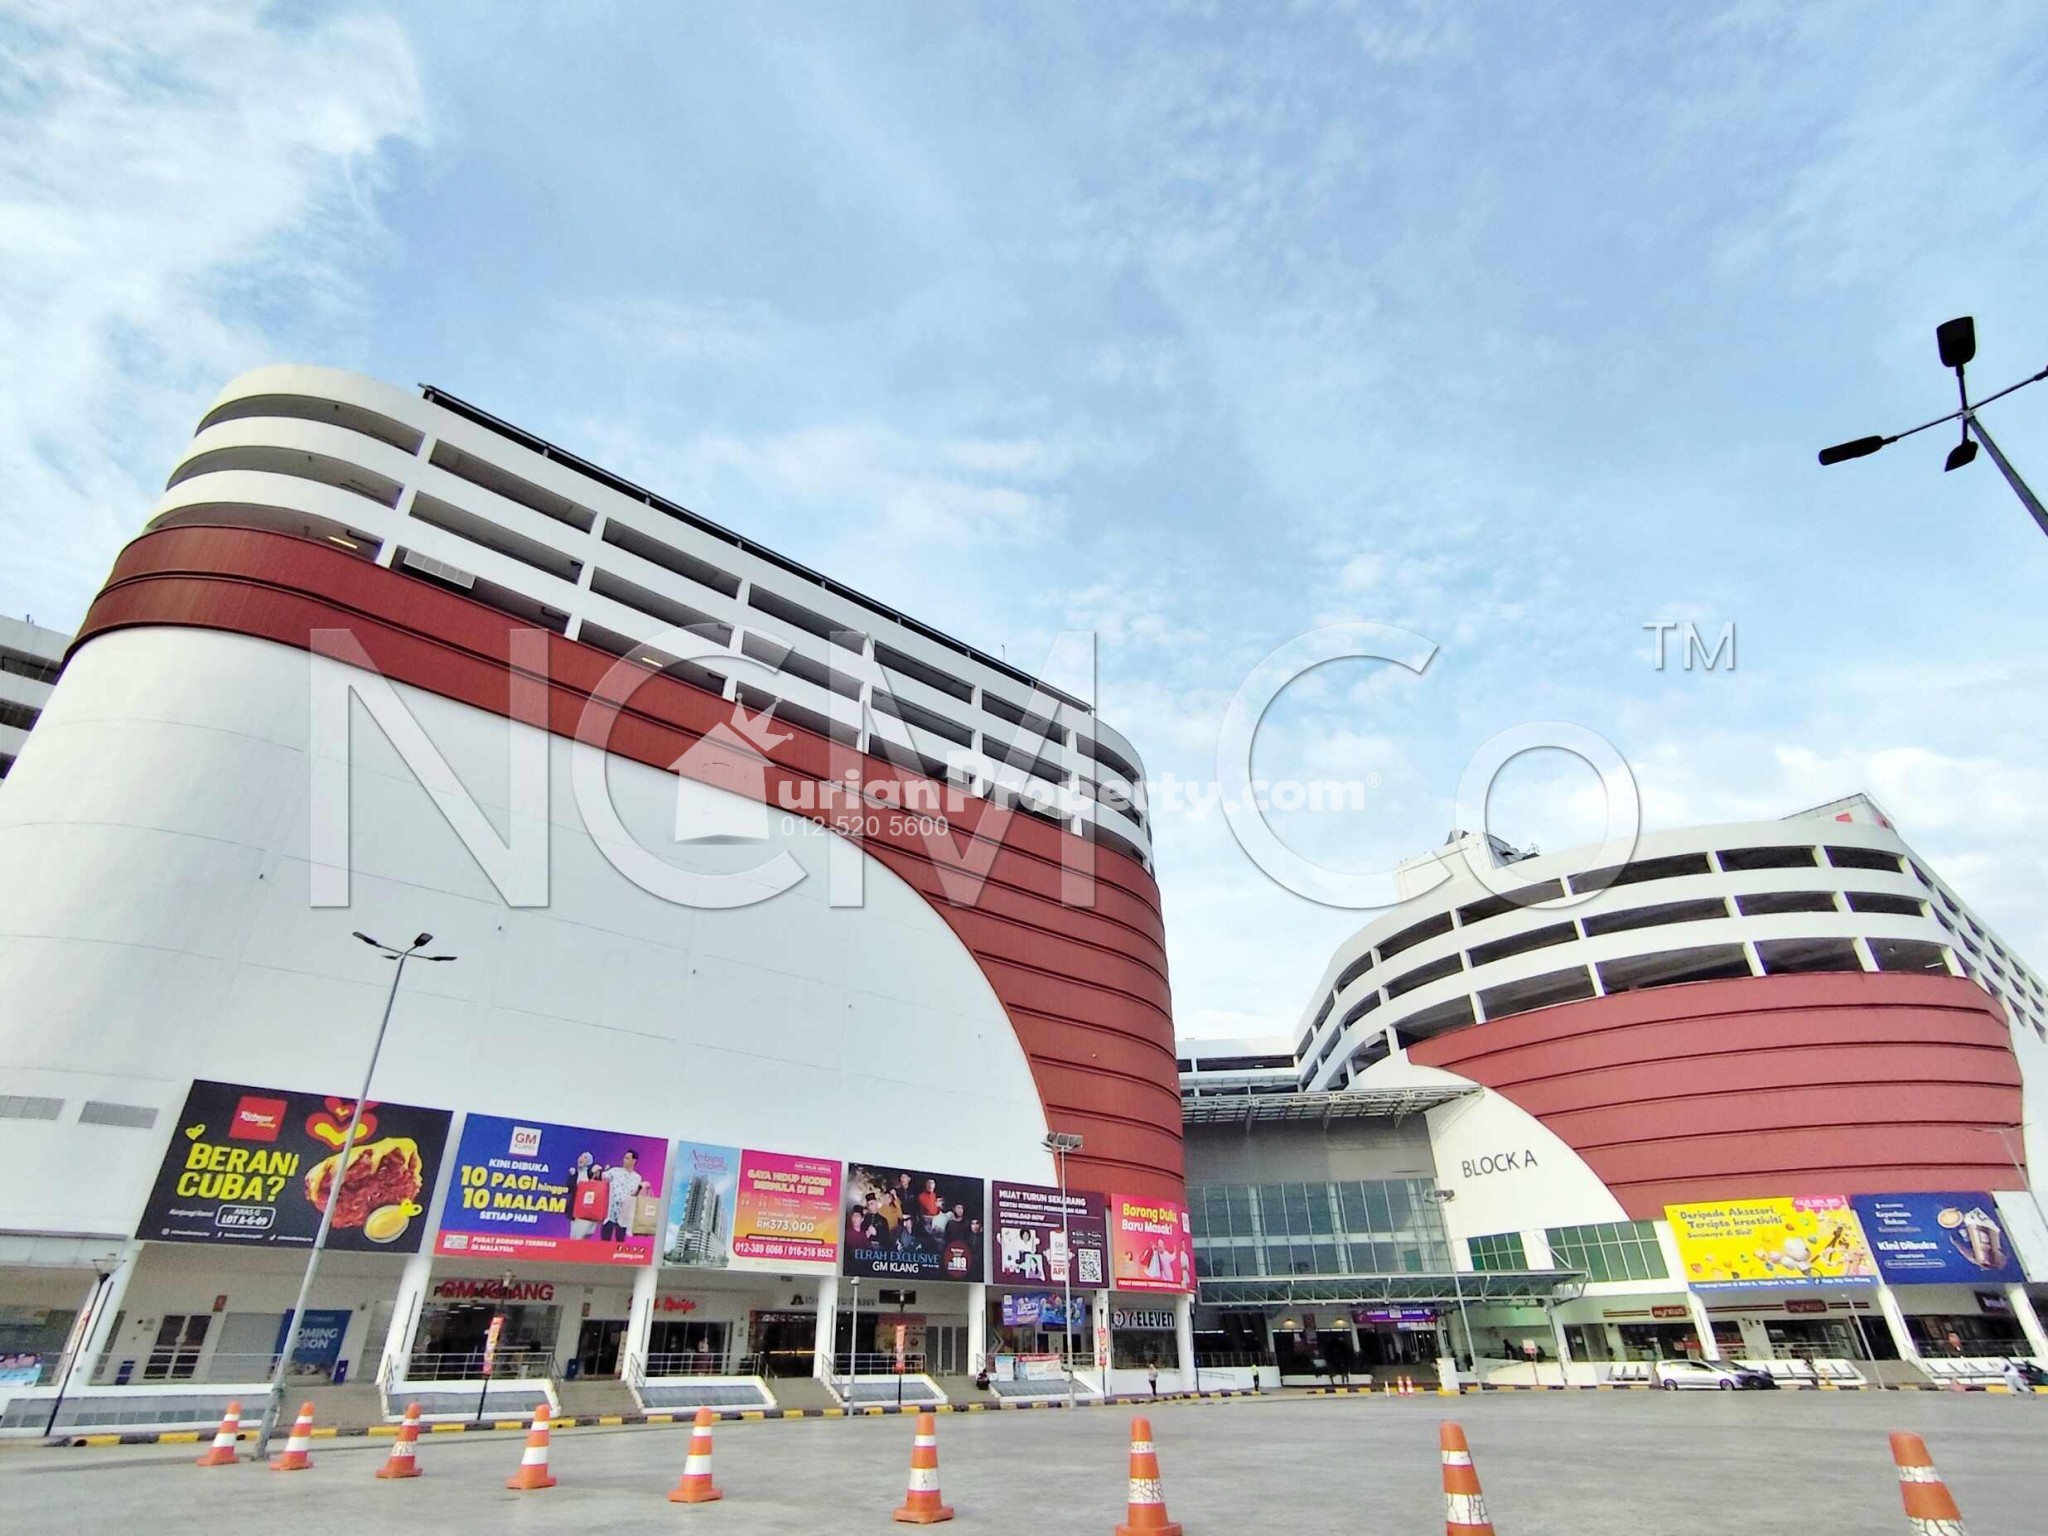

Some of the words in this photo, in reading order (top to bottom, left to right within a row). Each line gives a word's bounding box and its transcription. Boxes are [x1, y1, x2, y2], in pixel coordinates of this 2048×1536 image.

[515, 1132, 537, 1145] GM
[185, 1142, 300, 1178] BERANI
[488, 1158, 511, 1170] KINI
[511, 1160, 549, 1173] DIBUKA
[1461, 1151, 1520, 1178] BLOCK
[1524, 1149, 1538, 1168] A
[460, 1164, 488, 1187] 10
[491, 1172, 538, 1192] PAGI
[538, 1182, 569, 1195] hingga
[176, 1171, 287, 1203] CUBA?
[463, 1189, 490, 1209] 10
[493, 1193, 567, 1213] MALAM
[999, 1189, 1023, 1200] MUAT
[1022, 1192, 1048, 1203] TURUN
[221, 1214, 238, 1225] LOT
[480, 1211, 514, 1223] SETIAP
[515, 1213, 538, 1225] HARI
[1122, 1203, 1158, 1223] Borong
[1121, 1218, 1144, 1232] Baru
[1144, 1220, 1173, 1236] Masak!
[1687, 1220, 1731, 1230] Tercipta
[472, 1236, 494, 1246] PUSAT
[1877, 1240, 1900, 1251] Kini
[1899, 1240, 1938, 1251] Dibuka
[890, 1251, 940, 1264] EXCLUSIVE
[872, 1261, 889, 1271] GM
[890, 1262, 919, 1273] KLANG
[440, 1280, 477, 1299] GM
[484, 1280, 554, 1301] KLANG
[297, 1328, 339, 1339] OMING
